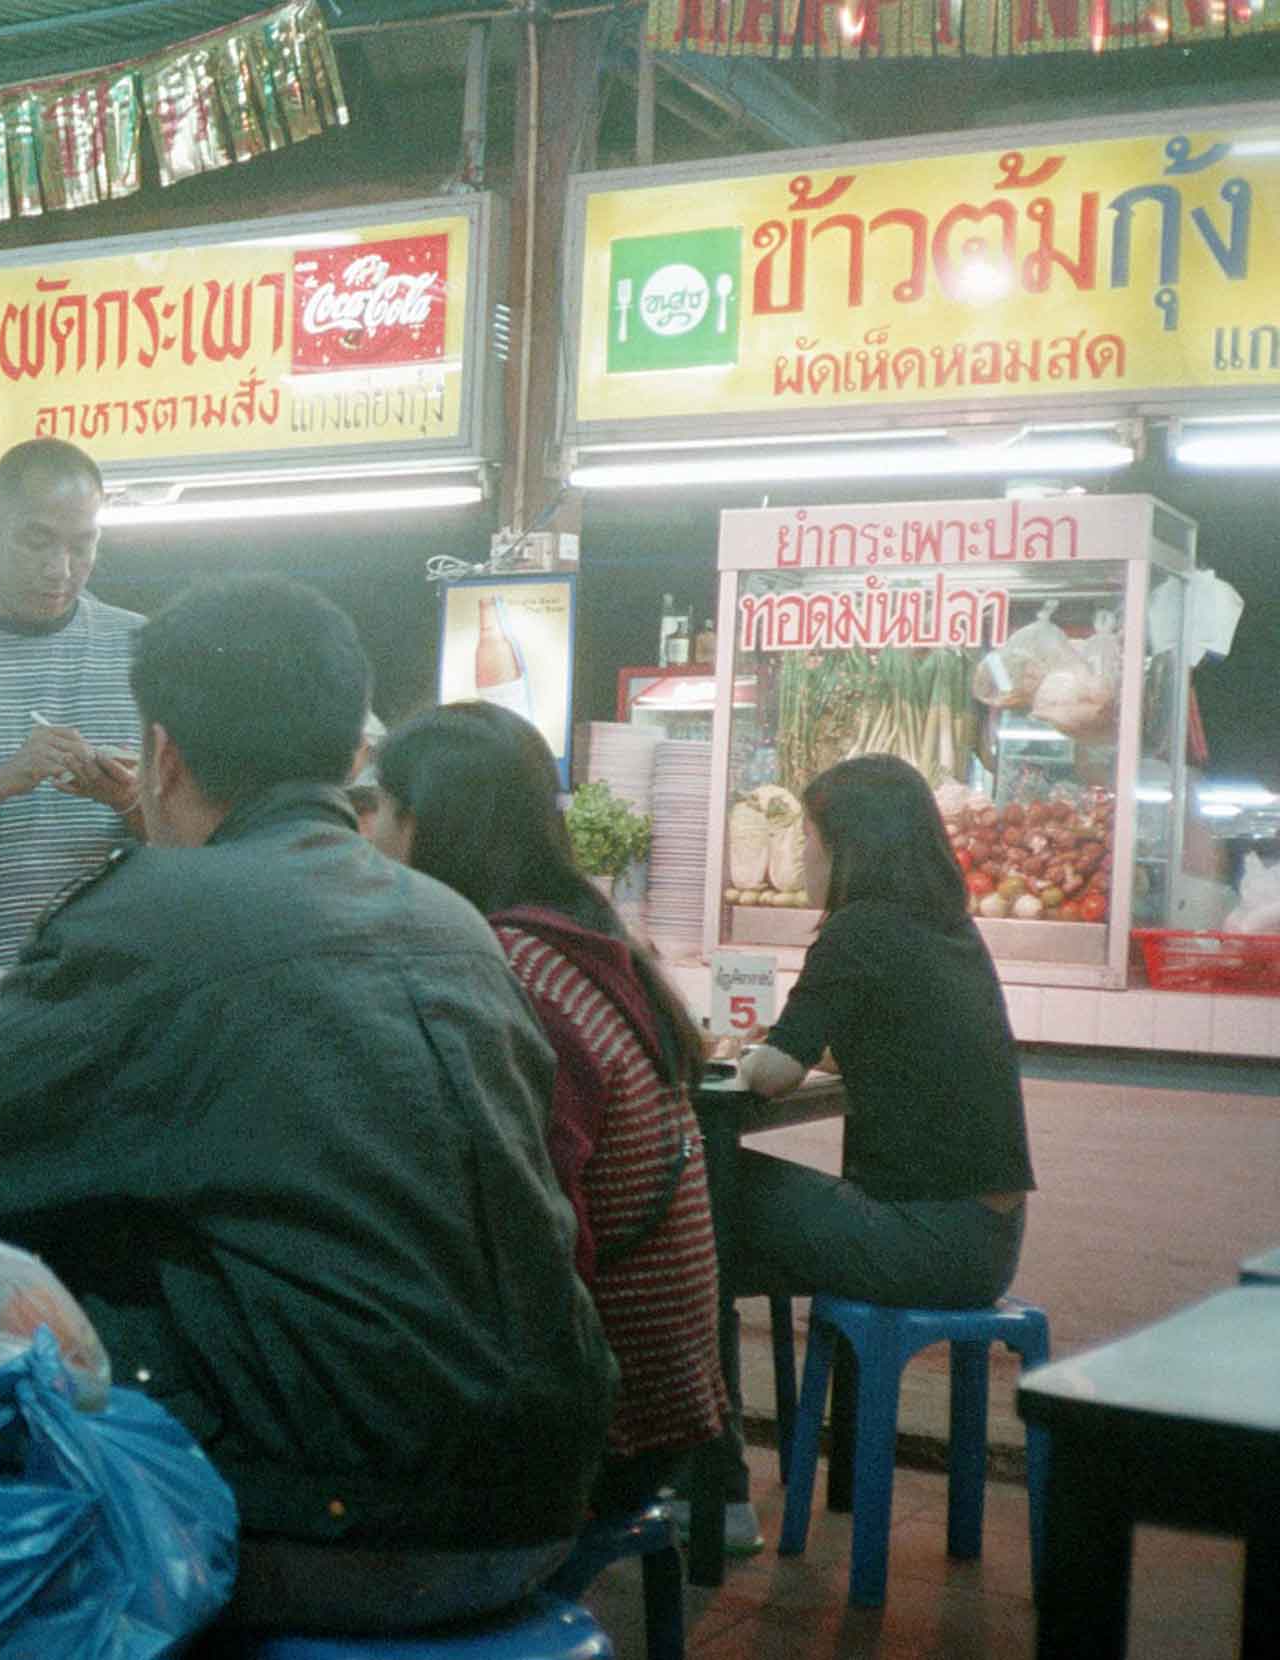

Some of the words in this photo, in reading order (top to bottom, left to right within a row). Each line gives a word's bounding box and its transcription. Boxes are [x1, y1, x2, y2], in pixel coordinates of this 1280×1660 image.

[303, 270, 438, 336] Coca-Cola
[772, 324, 1127, 397] ผัดเห็ดหอมสด
[34, 366, 280, 440] อาหารตามสั่ง
[775, 500, 1080, 568] ยำกระเพาะปลา
[742, 573, 1009, 649] ทอดมันปลา
[729, 995, 758, 1030] 5
